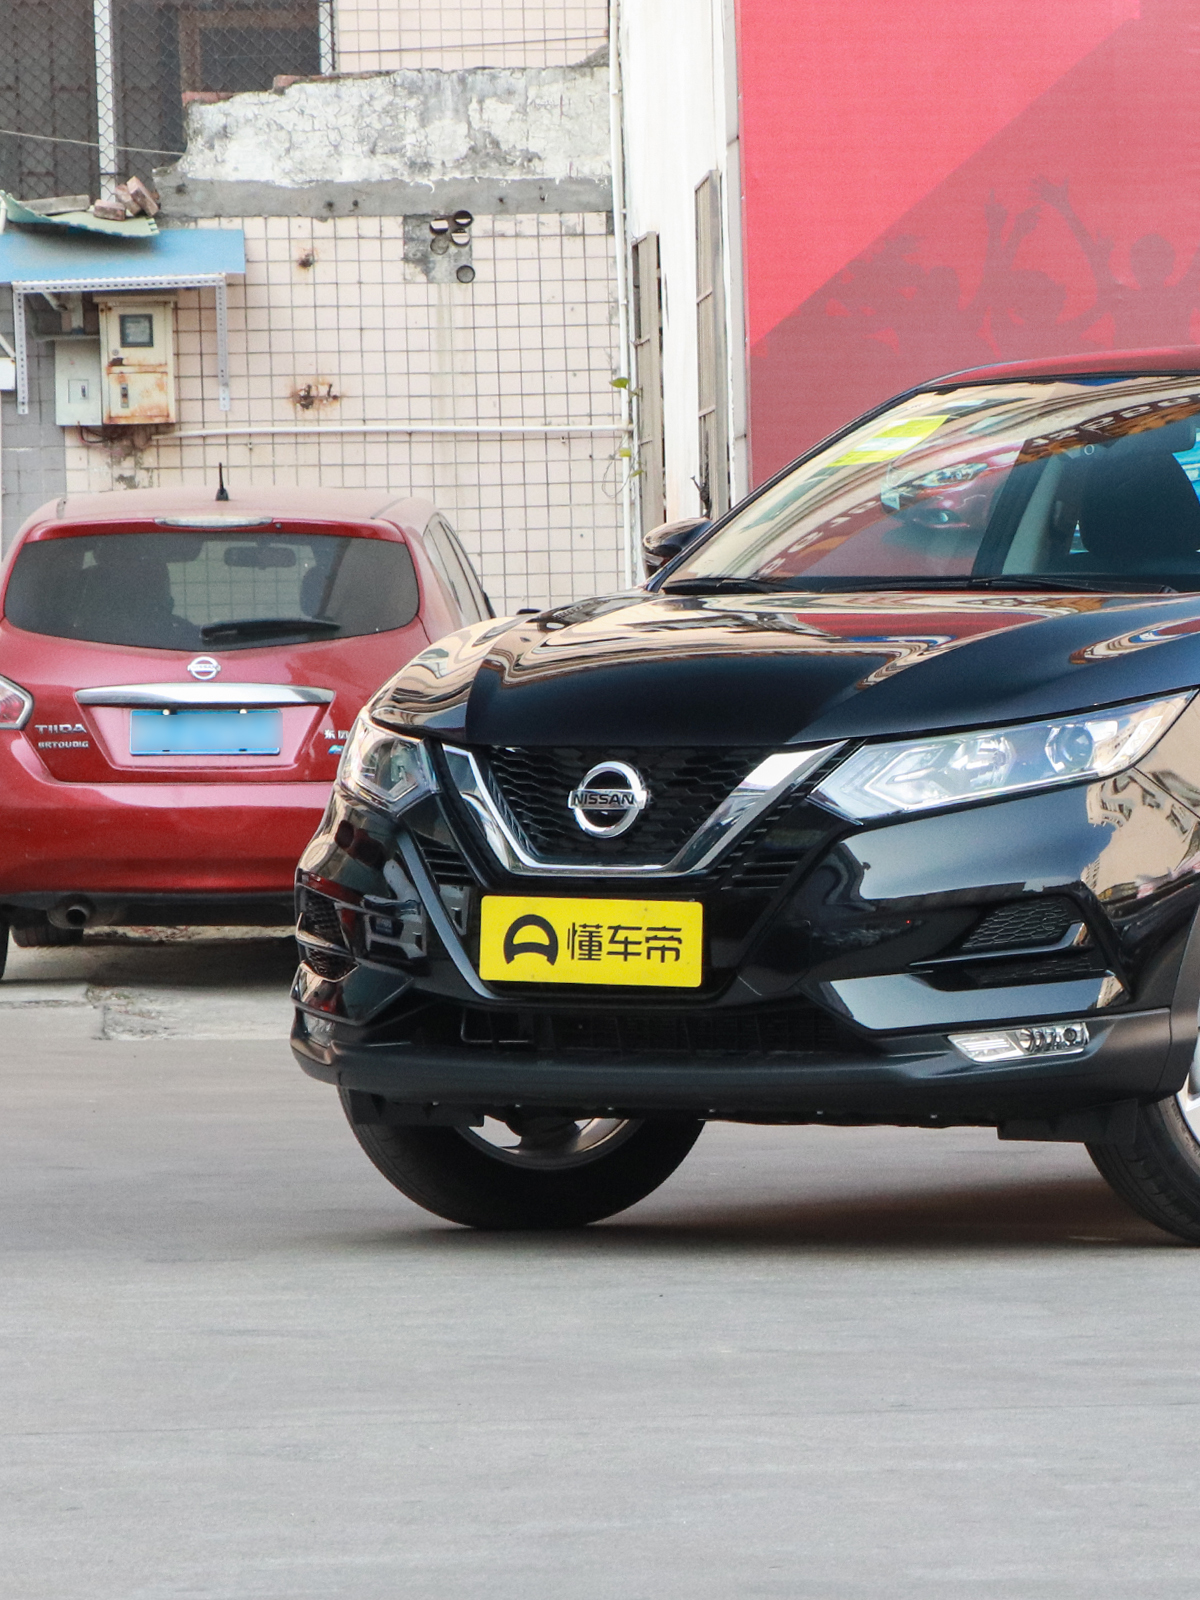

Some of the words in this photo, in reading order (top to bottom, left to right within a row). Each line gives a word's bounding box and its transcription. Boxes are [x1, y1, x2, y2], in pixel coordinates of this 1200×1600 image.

[34, 723, 87, 734] TIIDA
[572, 793, 634, 806] NISSAN
[567, 922, 683, 963] 懂车帝
